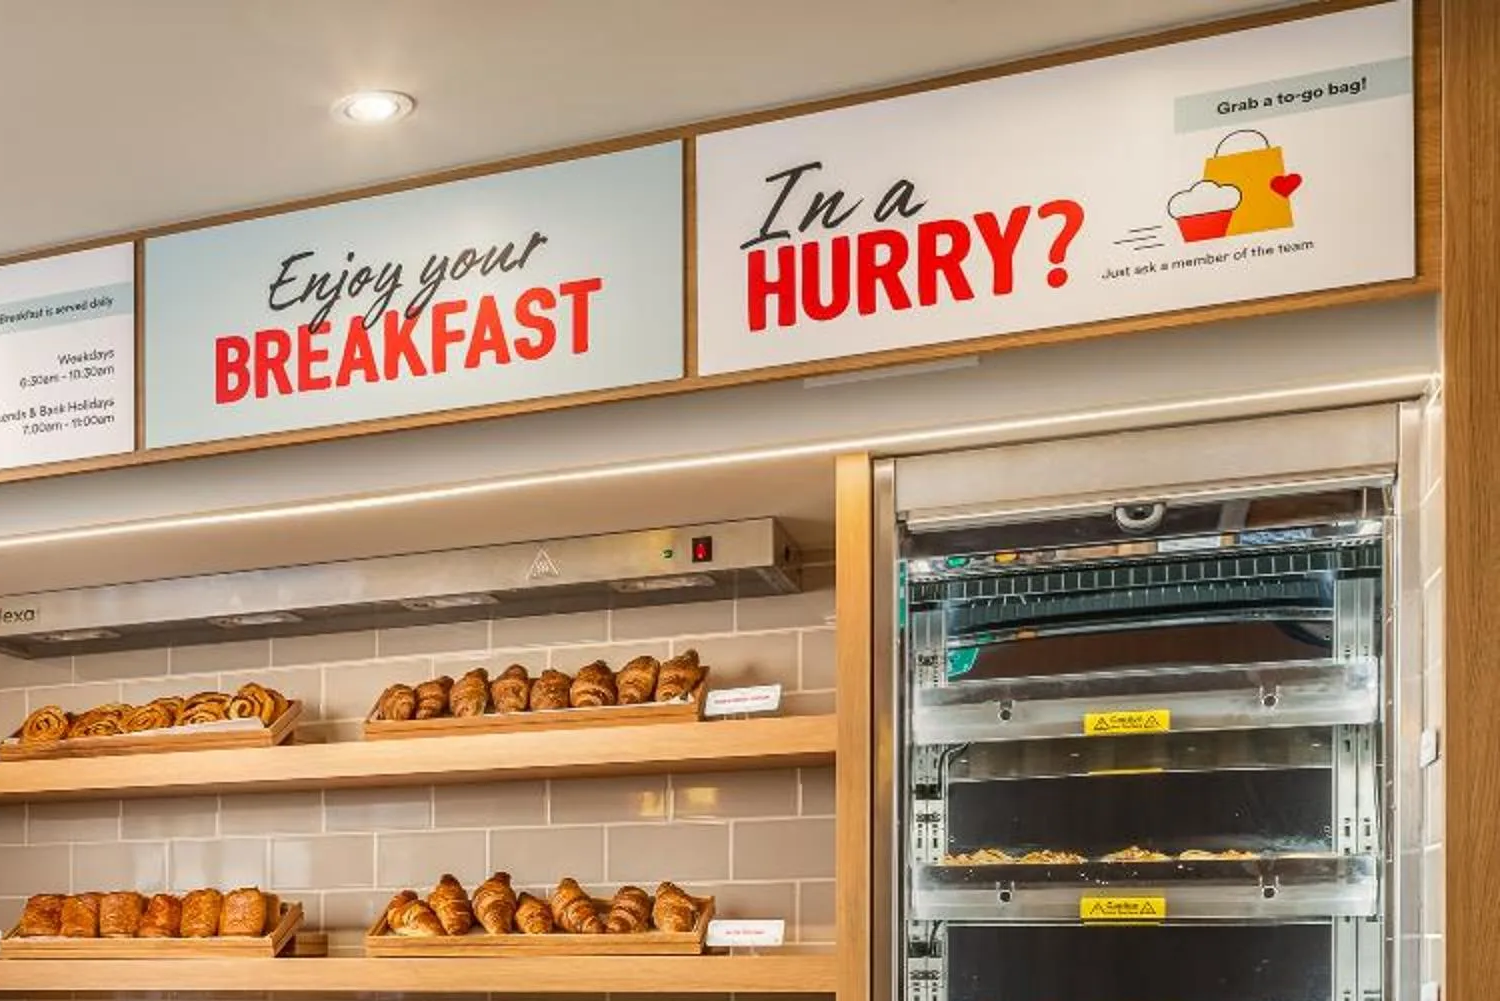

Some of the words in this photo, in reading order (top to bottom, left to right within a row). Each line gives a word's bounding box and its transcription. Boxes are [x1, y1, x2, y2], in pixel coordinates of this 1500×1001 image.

[1217, 97, 1259, 115] Grab
[1263, 97, 1273, 107] a
[1276, 87, 1323, 105] to-go
[1328, 76, 1367, 95] bag!
[739, 161, 865, 251] In
[875, 178, 928, 219] a
[747, 199, 1086, 333] HURRY?
[1101, 266, 1130, 279] Just
[1134, 262, 1157, 275] ask
[1160, 262, 1168, 271] a
[1171, 252, 1230, 270] member
[1233, 245, 1248, 261] of
[1251, 243, 1274, 257] the
[1278, 240, 1315, 255] team
[269, 251, 403, 335] Enjoy
[405, 230, 549, 320] your
[0, 308, 43, 325] Breakfast
[55, 301, 88, 315] served
[57, 349, 115, 366] Weekdays
[215, 277, 602, 405] BREAKFAST
[39, 403, 65, 418] Bank
[67, 396, 115, 413] Holidays
